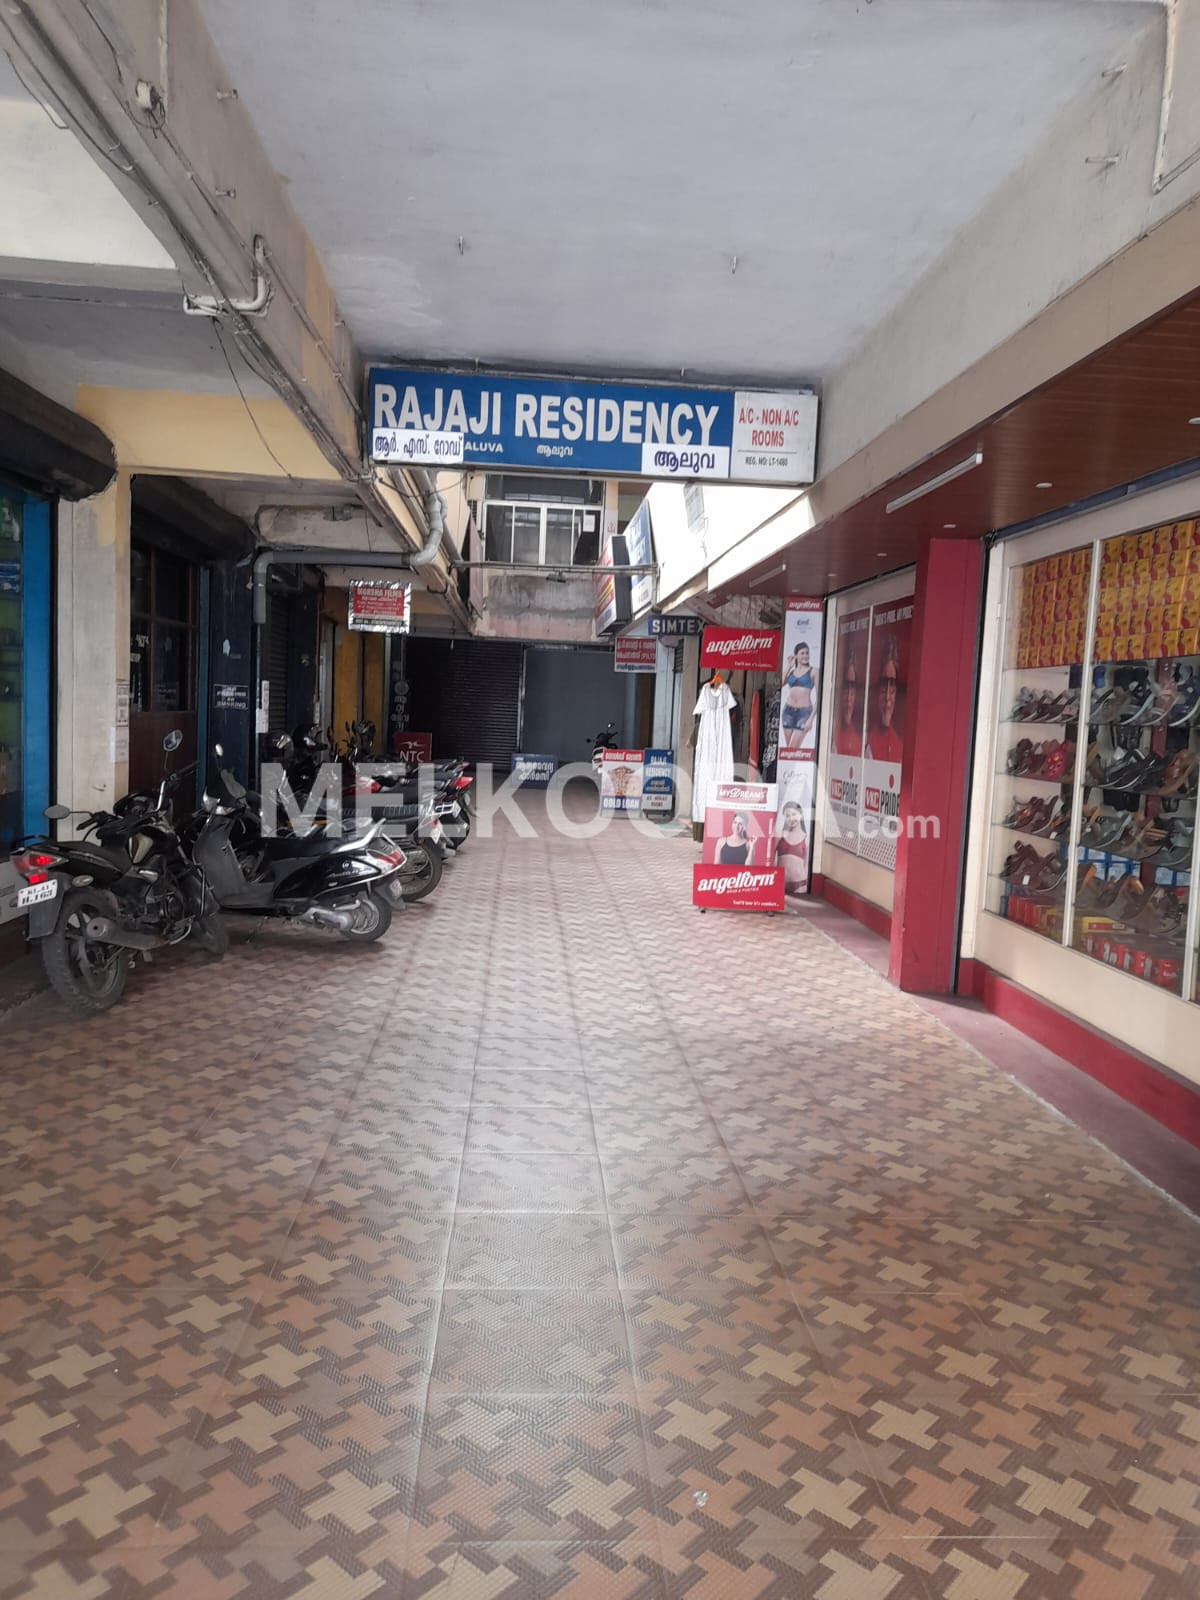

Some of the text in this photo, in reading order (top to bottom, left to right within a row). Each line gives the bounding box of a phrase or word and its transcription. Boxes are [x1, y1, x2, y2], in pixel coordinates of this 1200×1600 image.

[374, 383, 720, 447] RAJAJI RESIDENCY
[739, 408, 754, 424] A/C
[762, 409, 782, 425] NON
[784, 409, 799, 426] A/C
[464, 441, 504, 453] ALUVA
[752, 430, 785, 447] ROOMS
[536, 444, 573, 458] ആലുവ
[654, 450, 715, 473] ആലുവ
[652, 619, 705, 633] SIMTEX
[706, 634, 773, 656] angelform
[400, 750, 425, 763] NTC
[843, 781, 858, 806] PRIDE
[603, 797, 622, 809] GOLD
[622, 798, 640, 809] LOAN
[866, 789, 879, 810] VKC
[880, 790, 900, 818] PRIDE
[697, 871, 775, 895] angelform
